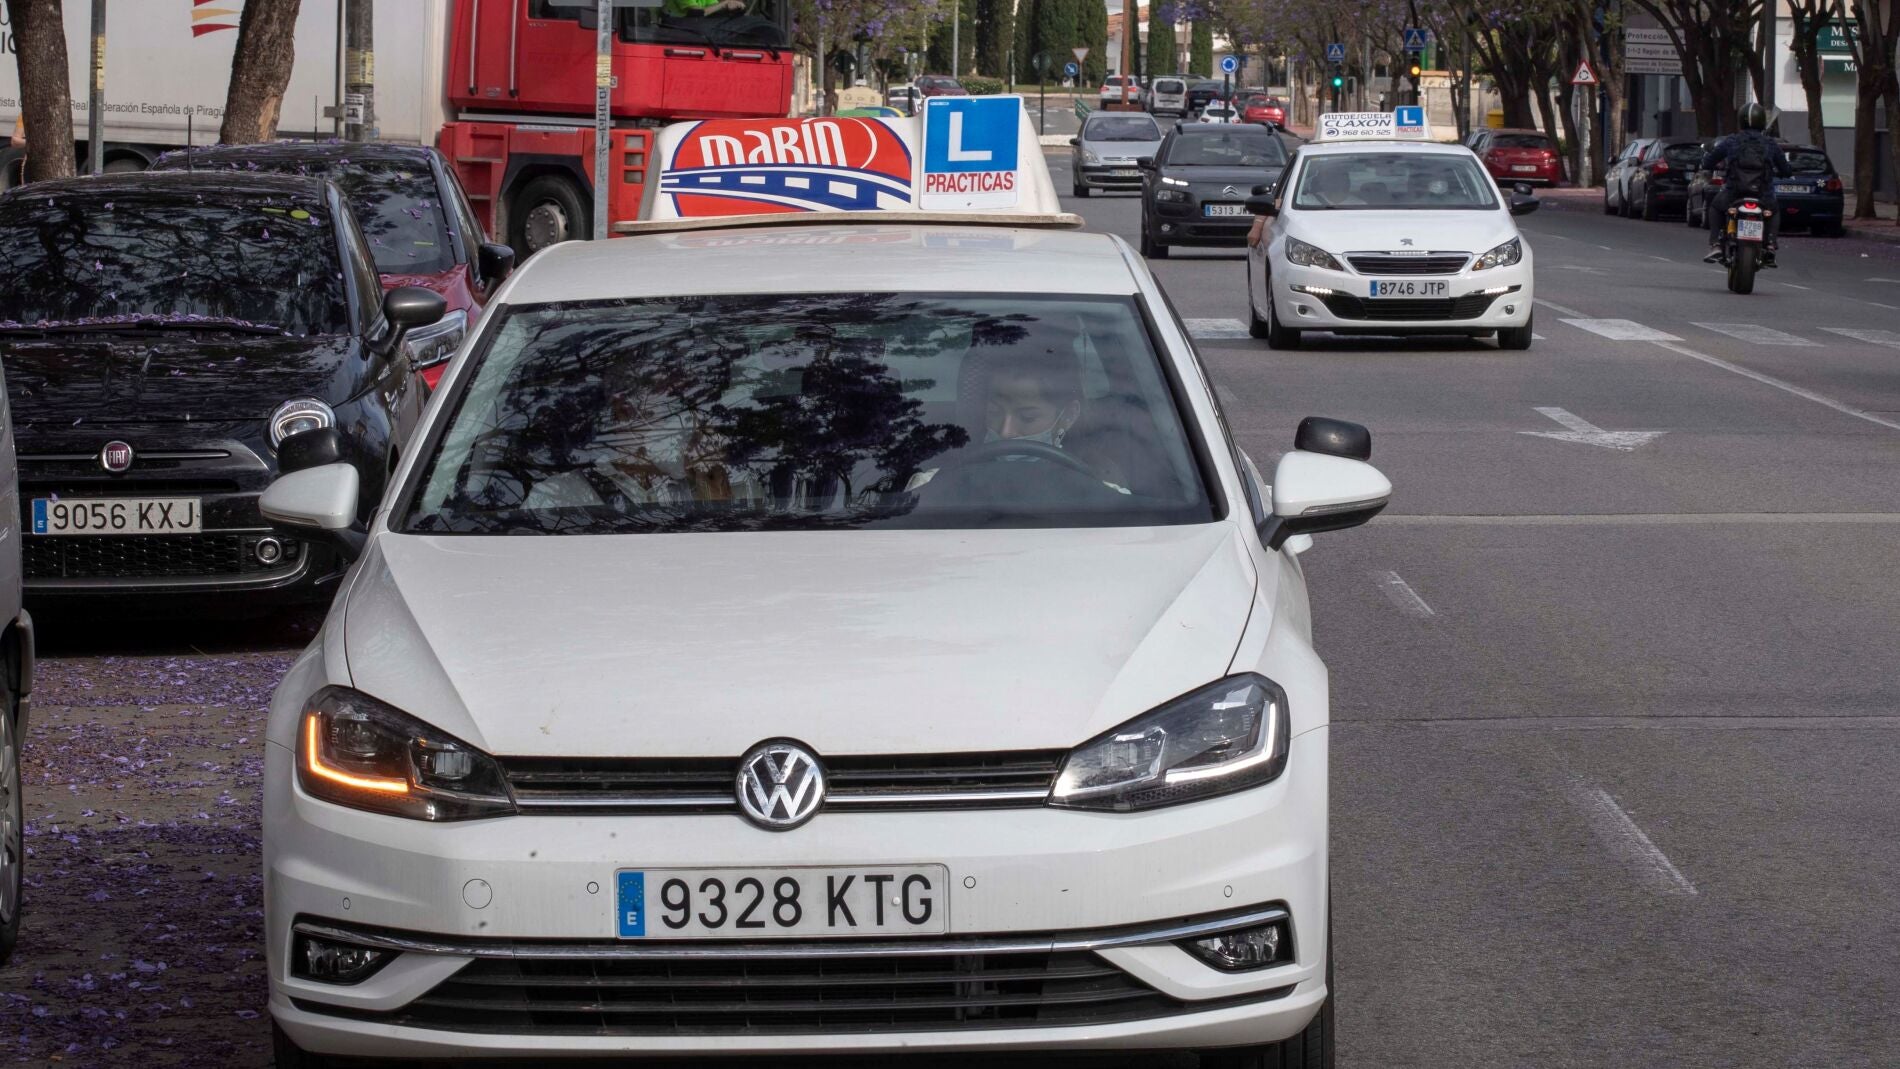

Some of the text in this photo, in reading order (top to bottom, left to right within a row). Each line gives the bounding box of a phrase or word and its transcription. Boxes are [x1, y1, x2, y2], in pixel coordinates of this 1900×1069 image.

[71, 100, 89, 110] Real
[102, 102, 139, 114] deración
[141, 103, 181, 116] Española
[183, 105, 194, 115] de
[1403, 110, 1417, 124] L
[947, 111, 993, 162] L
[925, 171, 1015, 194] PRACTICAS
[1211, 206, 1234, 215] 5313
[1380, 282, 1415, 295] 8746
[1420, 282, 1445, 295] JTP
[108, 450, 126, 464] FIAT
[53, 503, 127, 530] 9056
[138, 502, 194, 530] KXJ
[626, 873, 933, 930] E 9328 KTG
